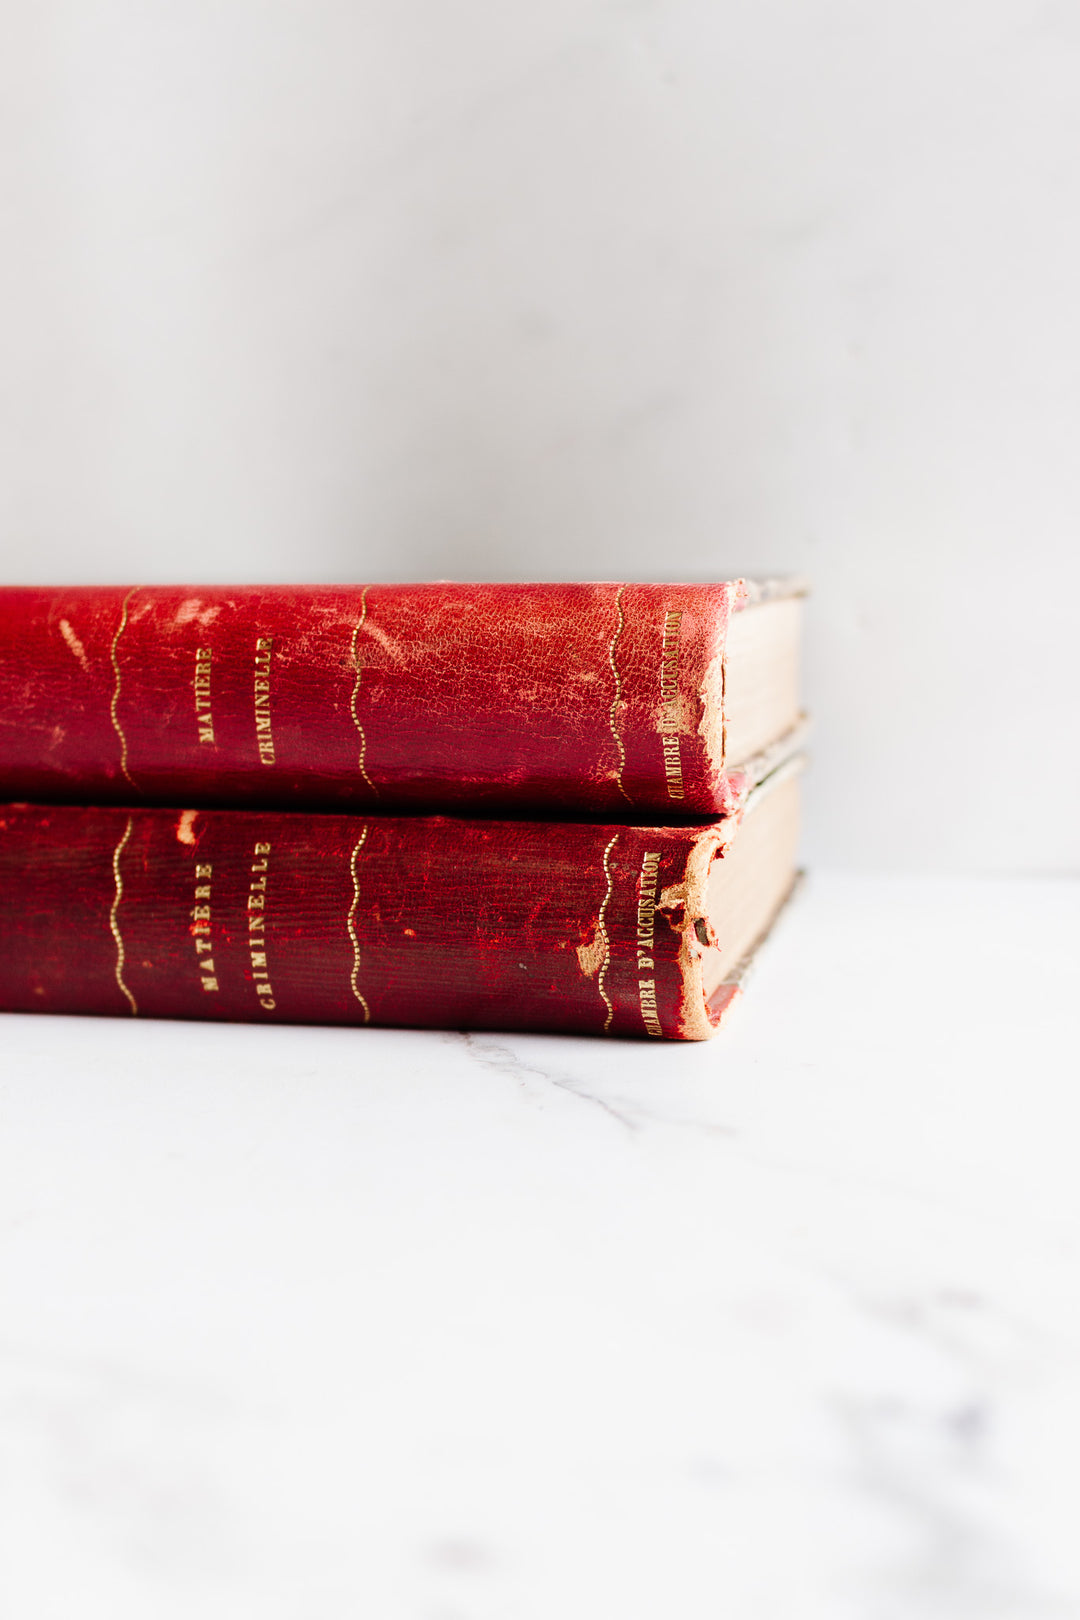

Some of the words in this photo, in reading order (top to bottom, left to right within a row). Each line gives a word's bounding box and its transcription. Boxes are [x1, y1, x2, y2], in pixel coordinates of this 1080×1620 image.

[190, 647, 214, 743] MATIÈRE
[255, 637, 276, 765] CRIMINELLE
[662, 736, 685, 800] CHAMBRE
[190, 864, 219, 992] MATIÈRE
[248, 841, 276, 1010] CRIMINELLE
[637, 851, 662, 970] D'ACCUSATION
[638, 979, 663, 1037] CHAMBRE
